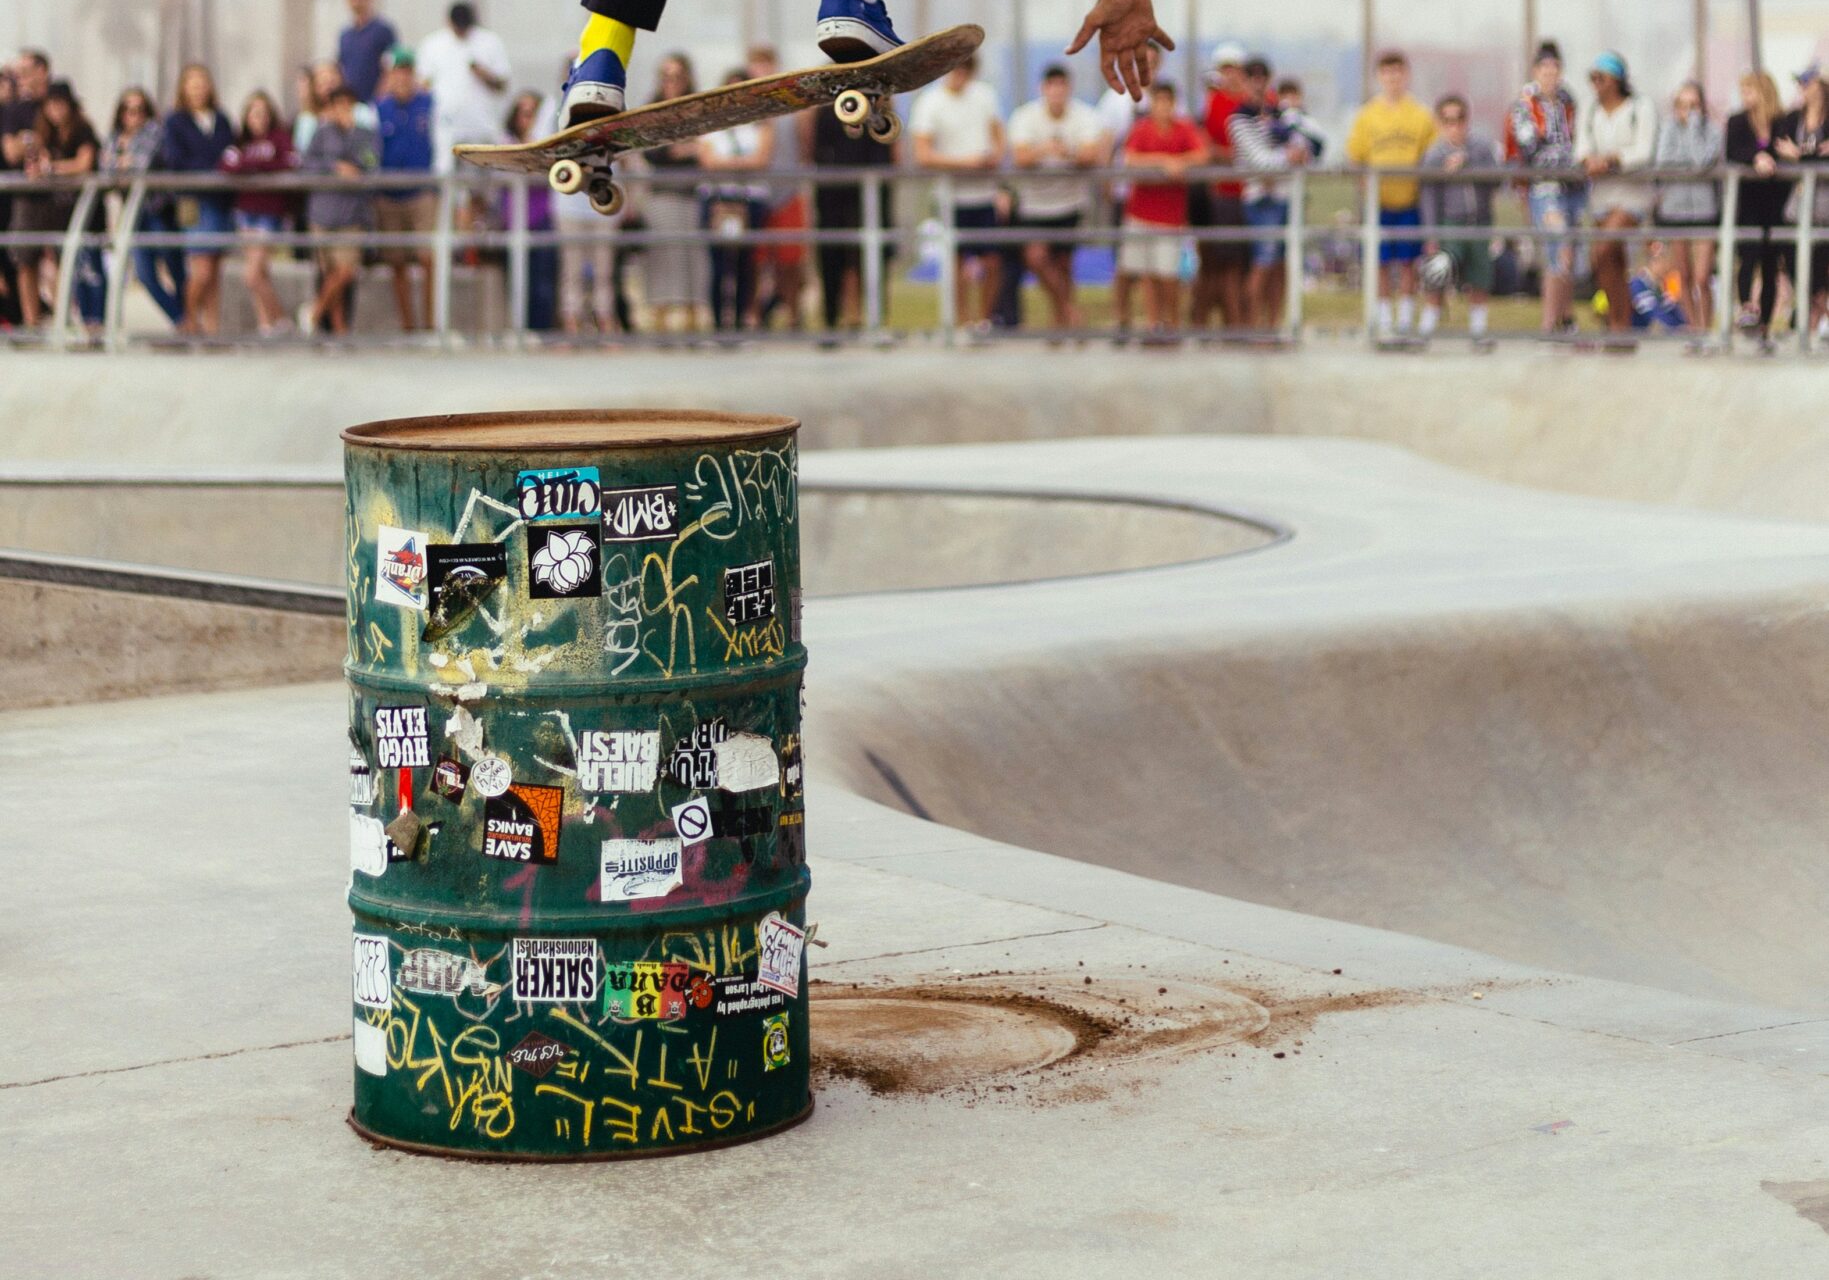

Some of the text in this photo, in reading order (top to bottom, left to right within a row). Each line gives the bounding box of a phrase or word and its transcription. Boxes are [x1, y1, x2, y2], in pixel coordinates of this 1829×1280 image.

[613, 493, 671, 535] BMD
[384, 559, 422, 584] Drank
[376, 707, 427, 738] ELVIS
[379, 737, 430, 768] HUGO
[487, 819, 534, 836] BANKS
[485, 838, 532, 860] SAVE
[516, 957, 594, 999] SAEKER
[725, 983, 749, 996] Larson
[771, 994, 781, 1005] was
[716, 1000, 726, 1015] by
[727, 994, 771, 1015] photographed
